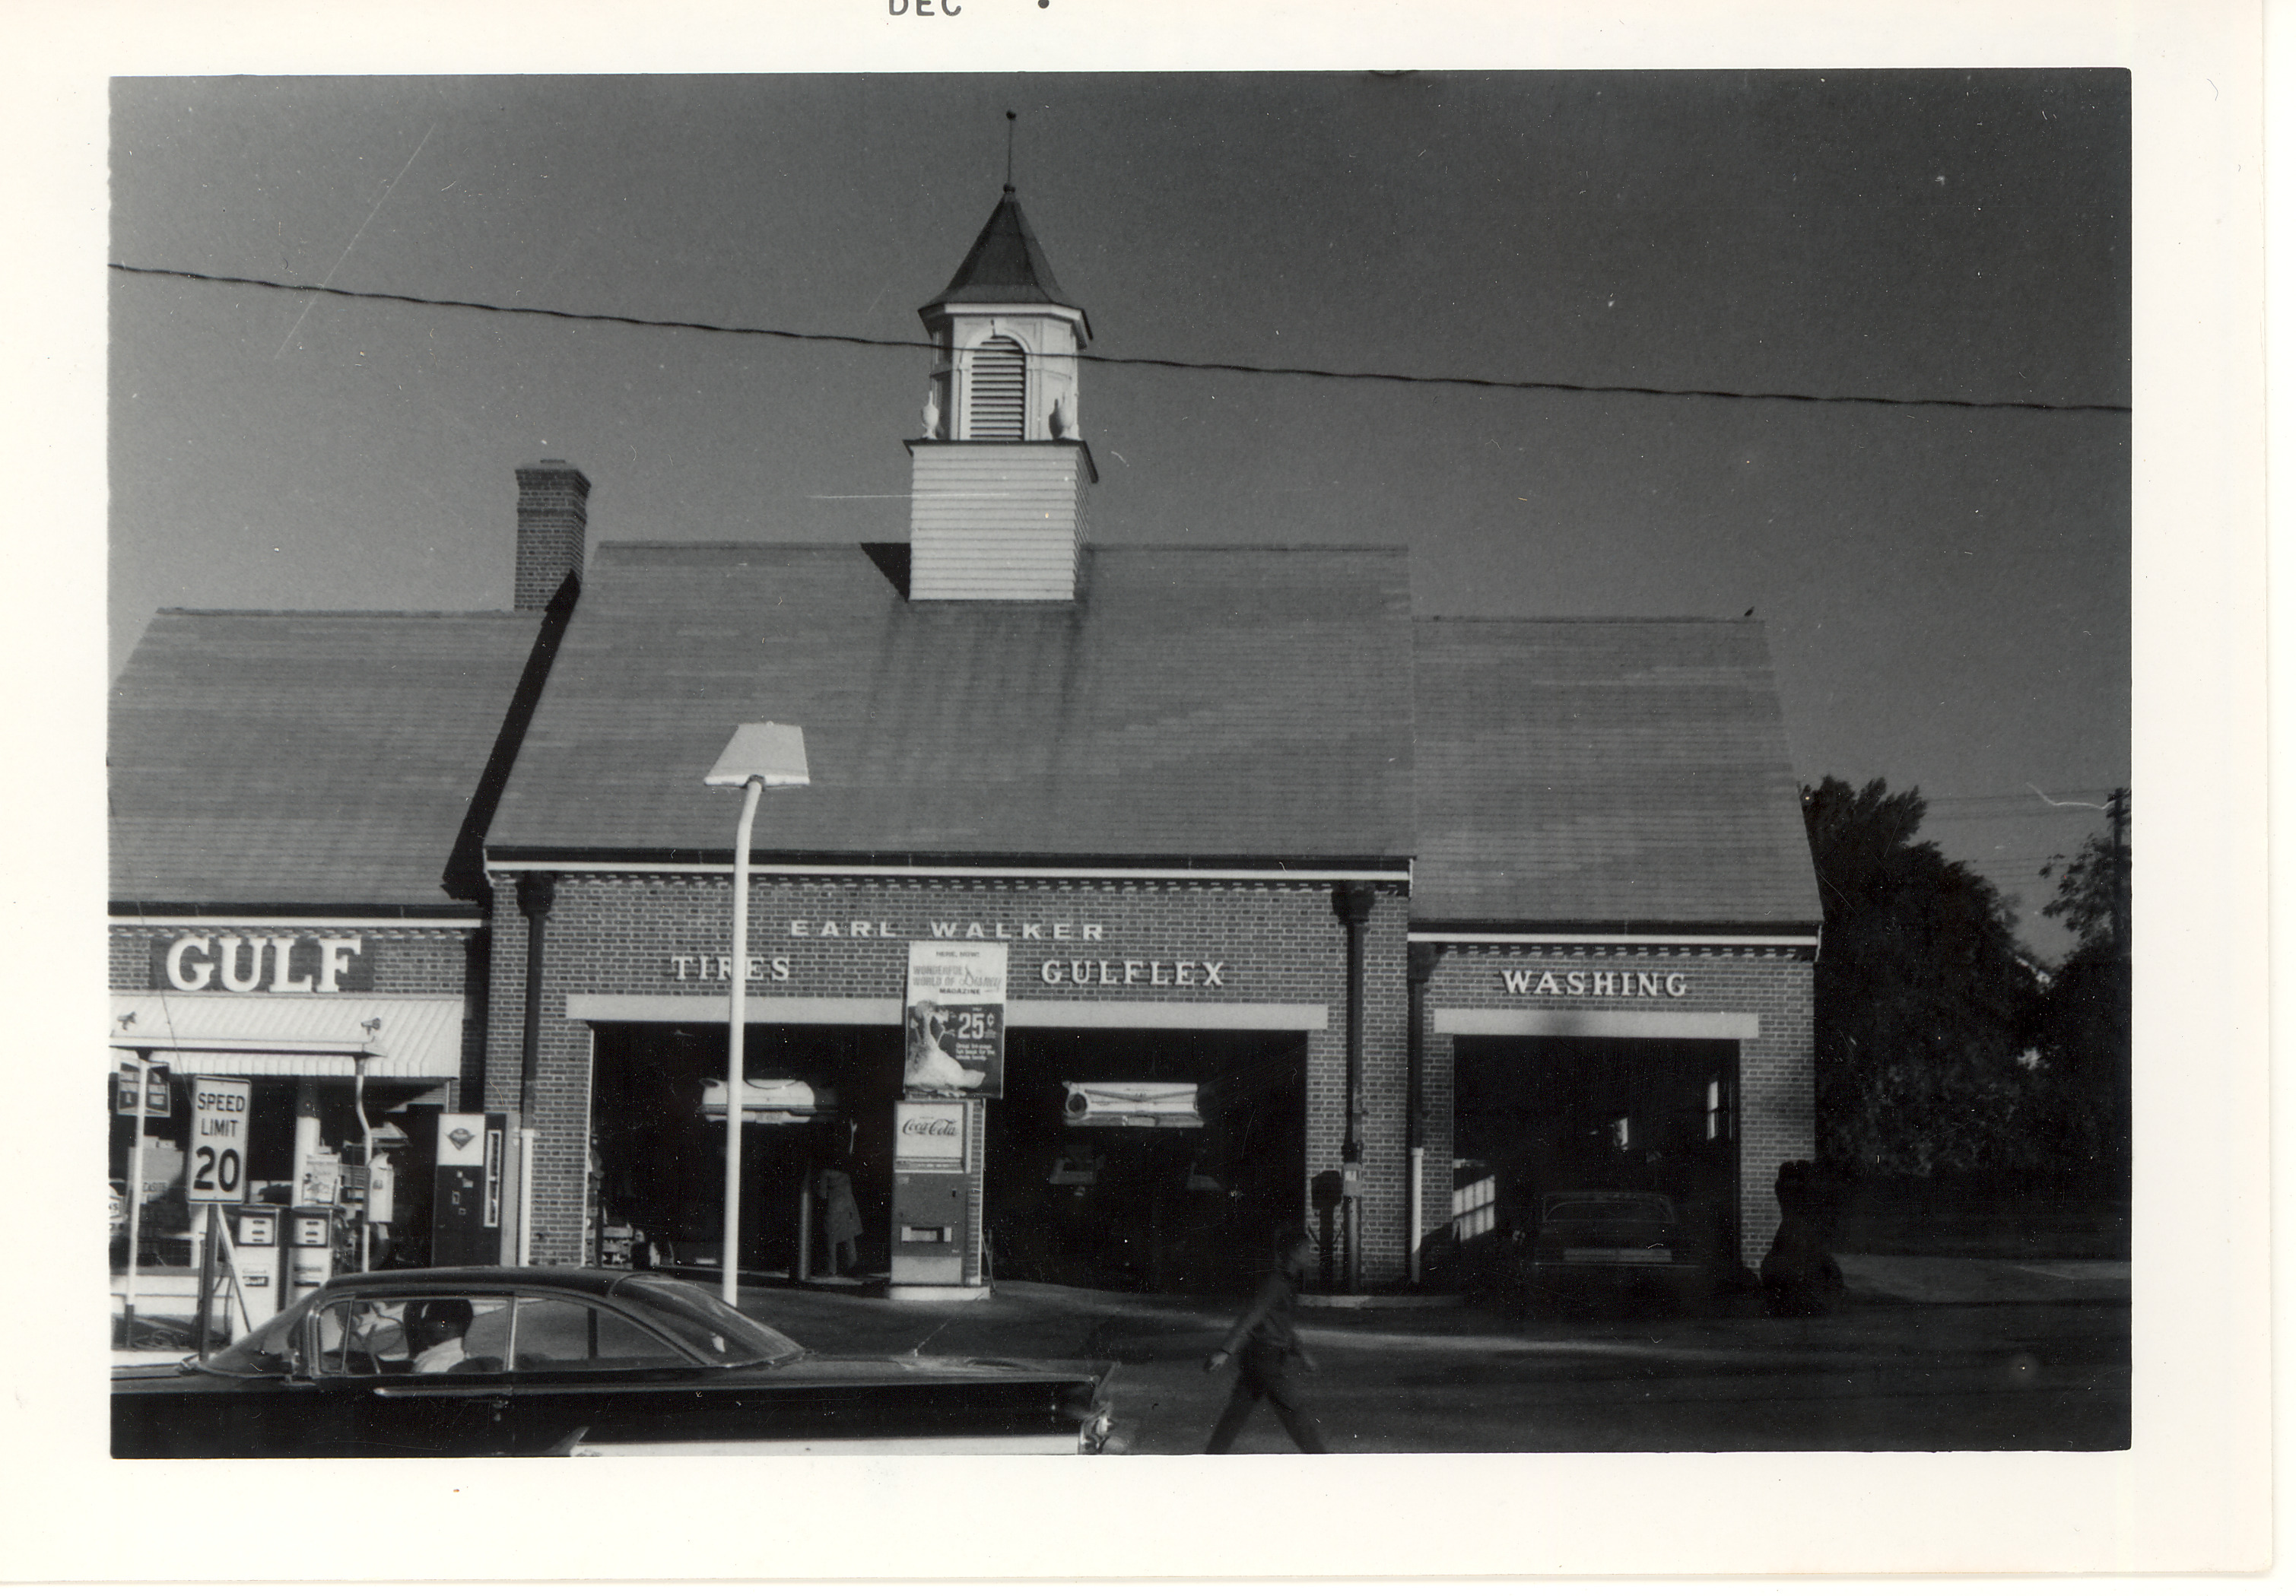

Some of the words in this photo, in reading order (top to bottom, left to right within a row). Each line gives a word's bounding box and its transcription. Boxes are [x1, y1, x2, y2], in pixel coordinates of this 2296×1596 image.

[791, 920, 896, 938] EARL
[930, 922, 1104, 941] WALKER
[167, 937, 361, 992] GULF
[672, 956, 789, 981] TIRES
[1041, 960, 1224, 986] GULFLEX
[945, 977, 954, 986] OF
[1501, 970, 1687, 997] WASHING
[197, 1093, 245, 1112] SPEED
[201, 1118, 238, 1137] LIMIT
[193, 1146, 240, 1191] 20
